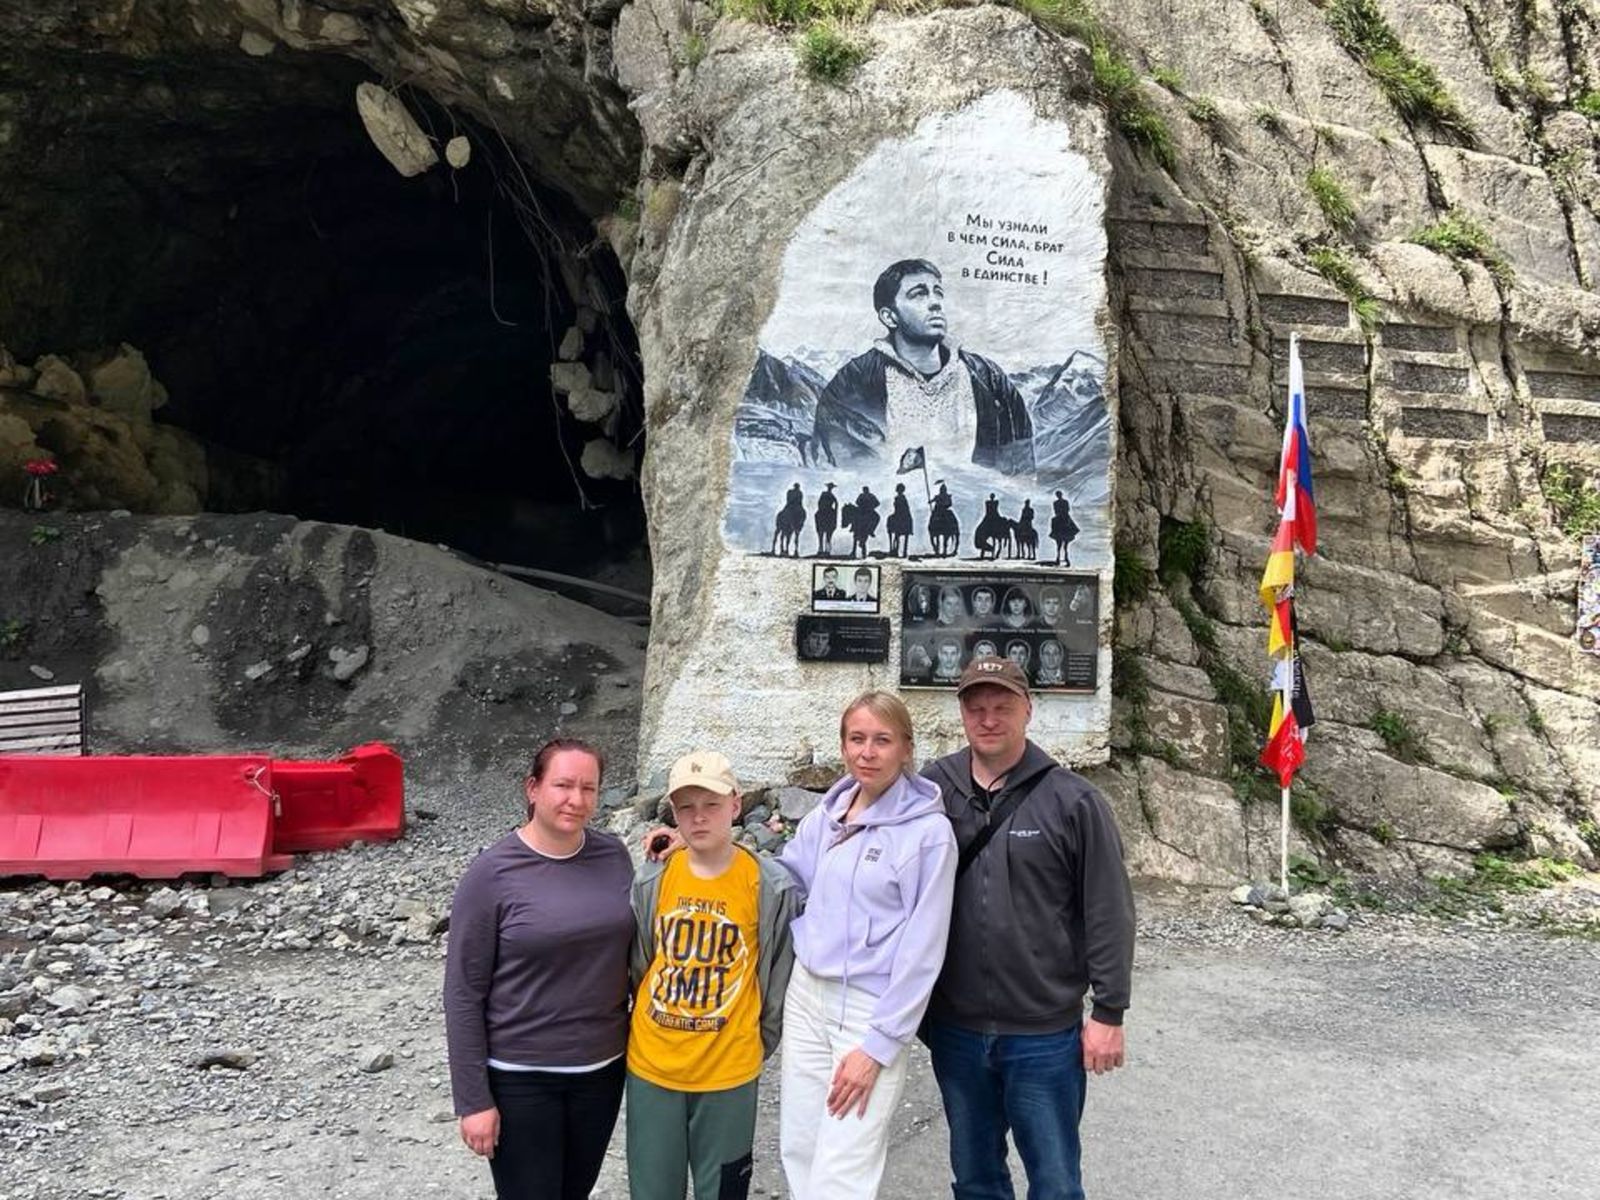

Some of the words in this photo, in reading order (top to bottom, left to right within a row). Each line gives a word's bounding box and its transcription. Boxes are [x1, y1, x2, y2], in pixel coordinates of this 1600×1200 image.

[998, 220, 1048, 235] УЗНАЛИ
[947, 231, 956, 242] В
[960, 233, 987, 245] ЧЕМ
[1034, 241, 1064, 253] БРАТ
[961, 267, 970, 278] В
[676, 896, 693, 911] THE
[694, 898, 714, 914] SKY
[715, 901, 727, 916] IS
[660, 915, 740, 965] YOUR
[653, 965, 730, 1009] LIMIT
